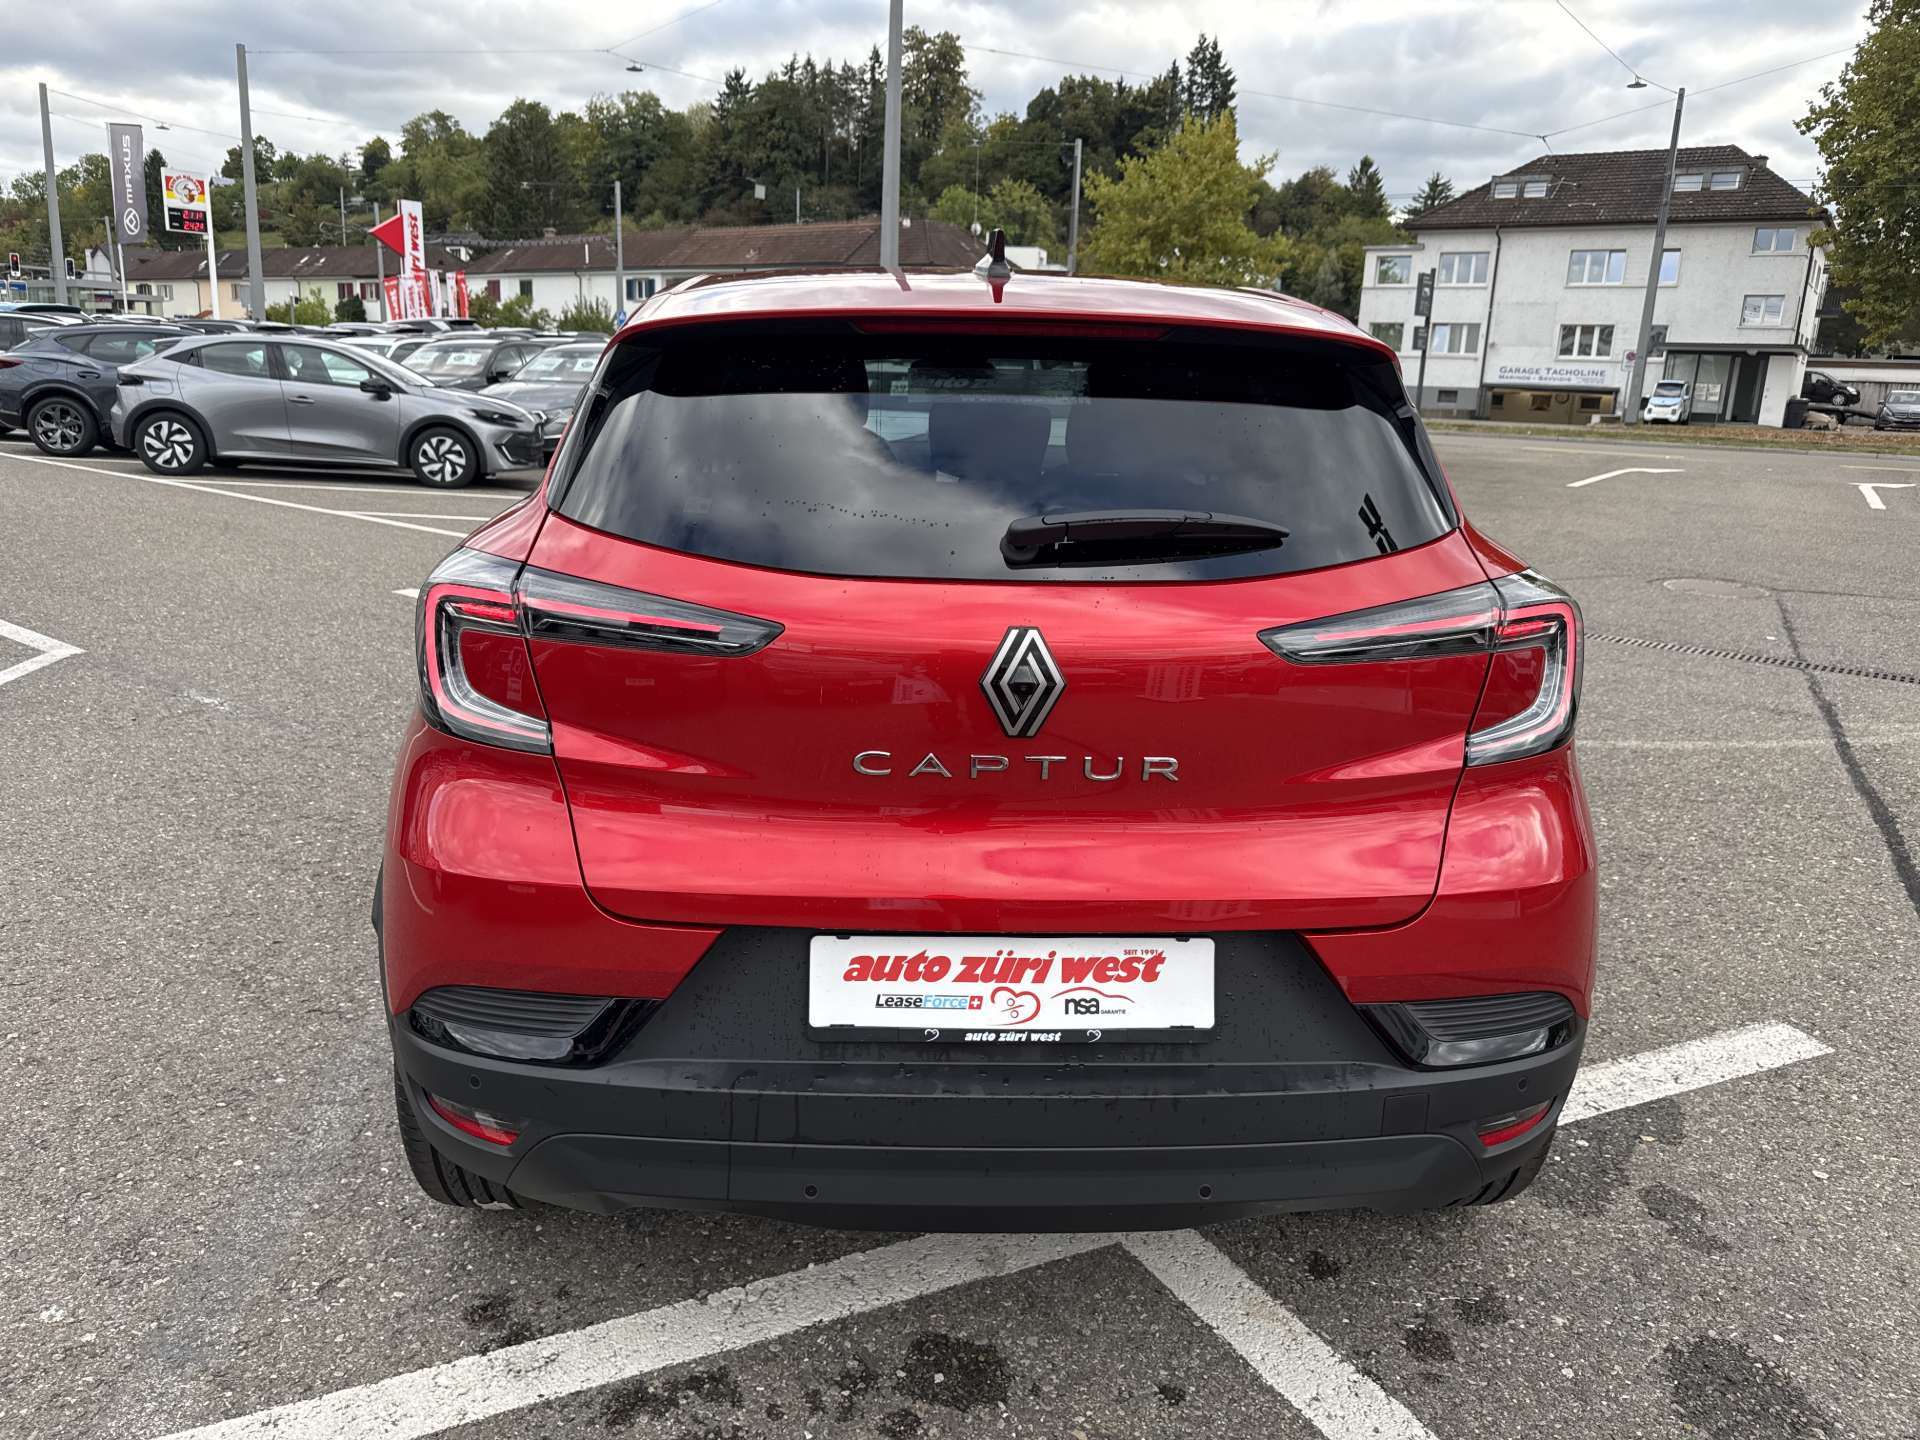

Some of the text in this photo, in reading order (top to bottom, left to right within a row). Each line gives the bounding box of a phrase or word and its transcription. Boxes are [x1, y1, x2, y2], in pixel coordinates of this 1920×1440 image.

[122, 134, 134, 203] MAXUS
[1498, 366, 1606, 377] GARAGE TACHOLINE
[852, 749, 1180, 782] CAPTUR
[843, 948, 1167, 984] auto züri west
[875, 993, 969, 1009] LeaseForce
[1064, 997, 1100, 1015] nsa
[964, 1031, 1062, 1042] auto züri west
